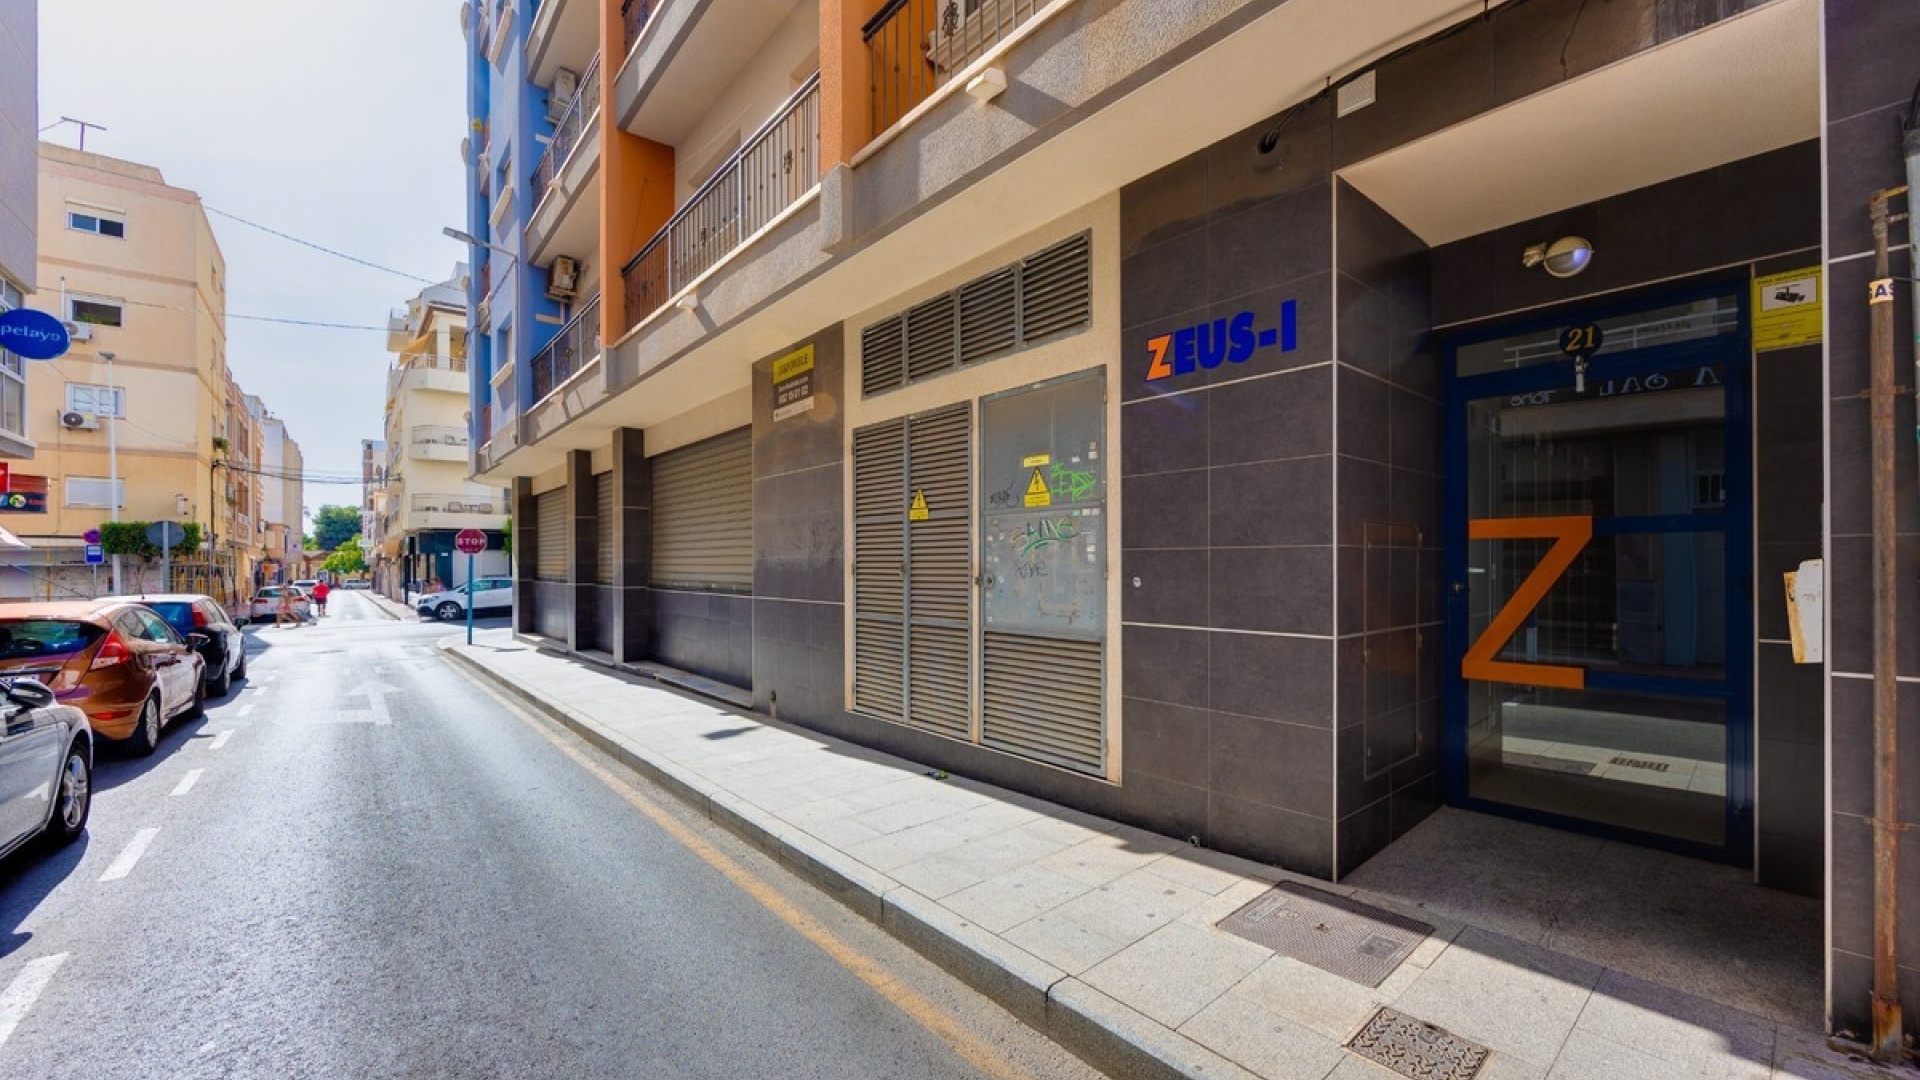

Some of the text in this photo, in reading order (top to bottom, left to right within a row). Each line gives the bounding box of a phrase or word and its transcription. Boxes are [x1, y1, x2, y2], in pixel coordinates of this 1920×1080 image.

[1146, 299, 1296, 380] ZEUS-I
[1566, 326, 1596, 351] 21
[458, 537, 485, 546] STOP
[1462, 516, 1592, 690] Z
